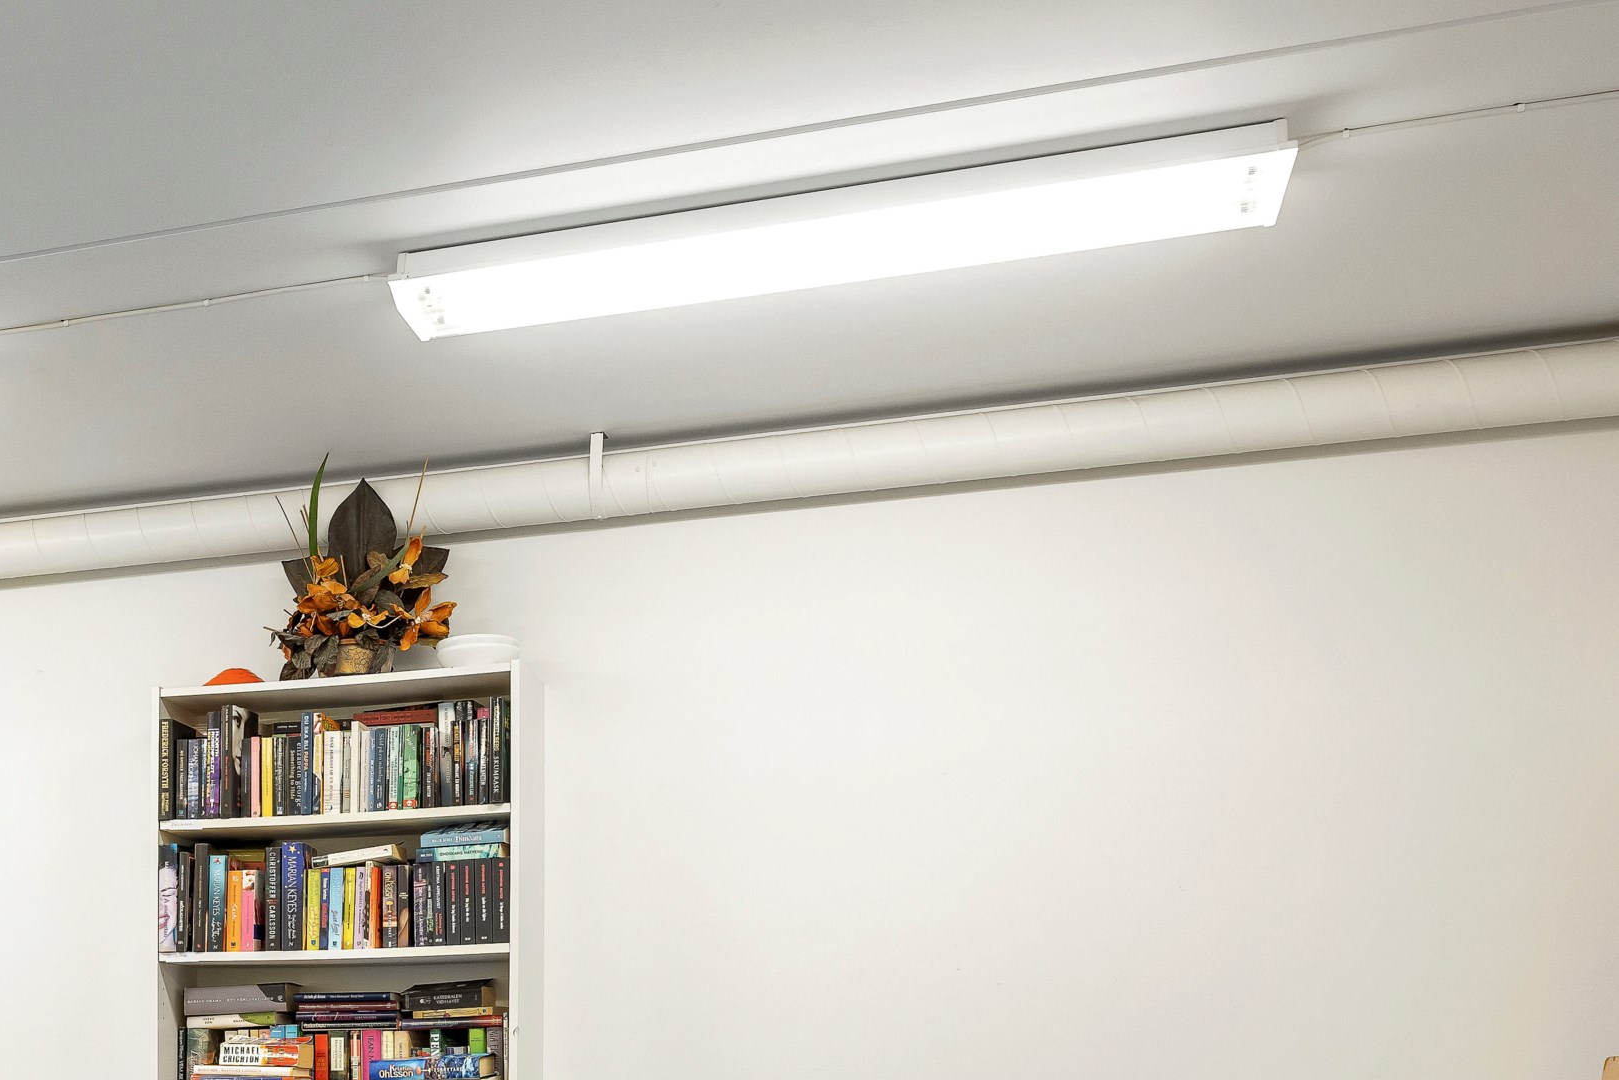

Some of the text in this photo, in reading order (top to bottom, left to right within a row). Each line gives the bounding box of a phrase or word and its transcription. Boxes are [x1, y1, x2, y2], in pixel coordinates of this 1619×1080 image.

[161, 722, 169, 757] FREDERICK
[161, 759, 169, 789] FORSYTH
[213, 869, 221, 895] MARIAN
[287, 856, 297, 913] MARIAN KEYES
[385, 872, 394, 900] Ohlsson
[223, 1046, 260, 1054] MICHAEL
[223, 1055, 260, 1063] CRICHTON
[379, 1070, 413, 1078] Ohlsson
